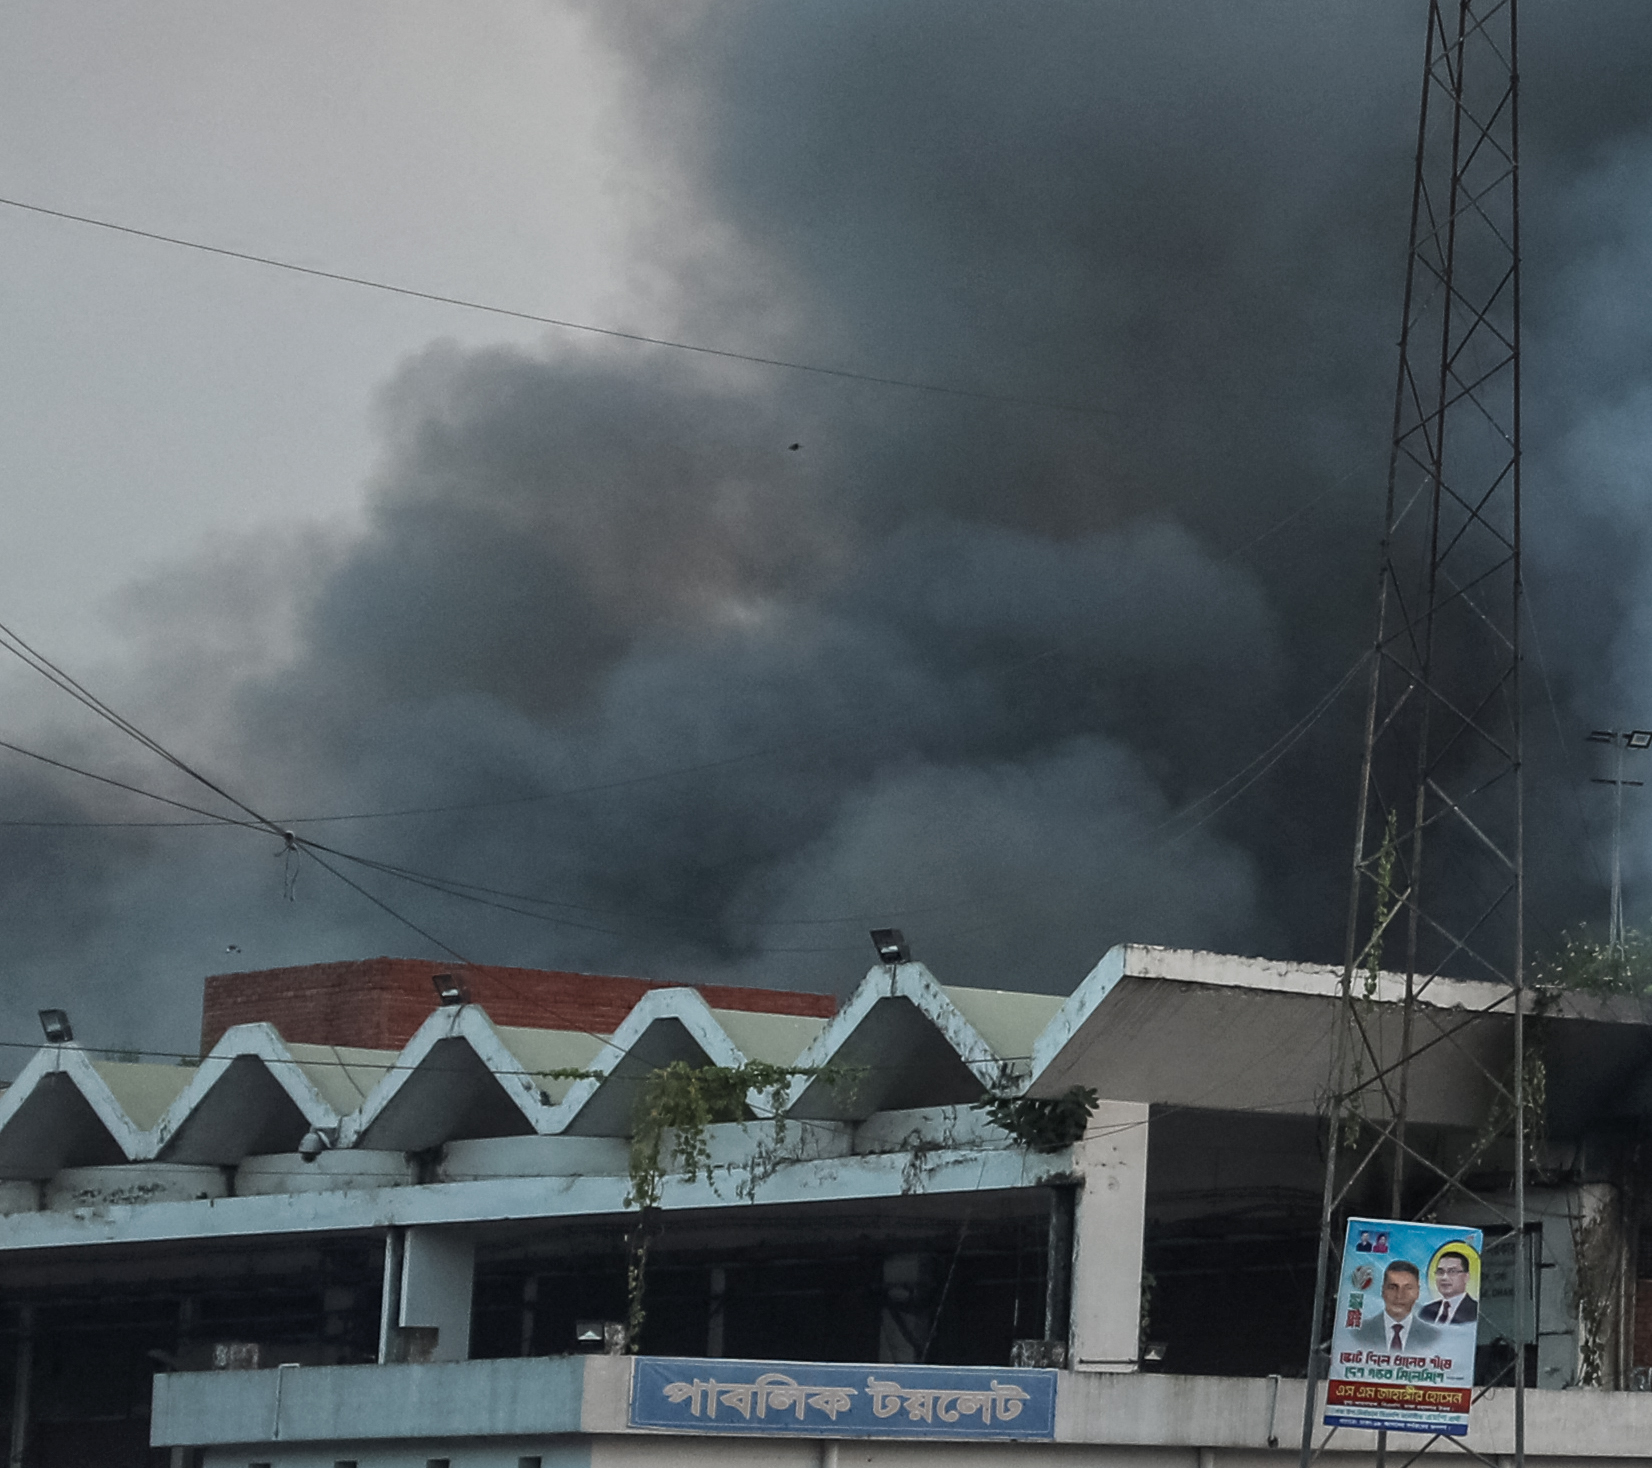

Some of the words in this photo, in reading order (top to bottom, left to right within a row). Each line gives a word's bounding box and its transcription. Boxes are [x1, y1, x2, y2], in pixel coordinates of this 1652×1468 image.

[663, 1373, 858, 1420] পাবলিক
[866, 1377, 1031, 1425] টয়লেট
[1336, 1385, 1354, 1397] এস
[1356, 1387, 1375, 1399] এম
